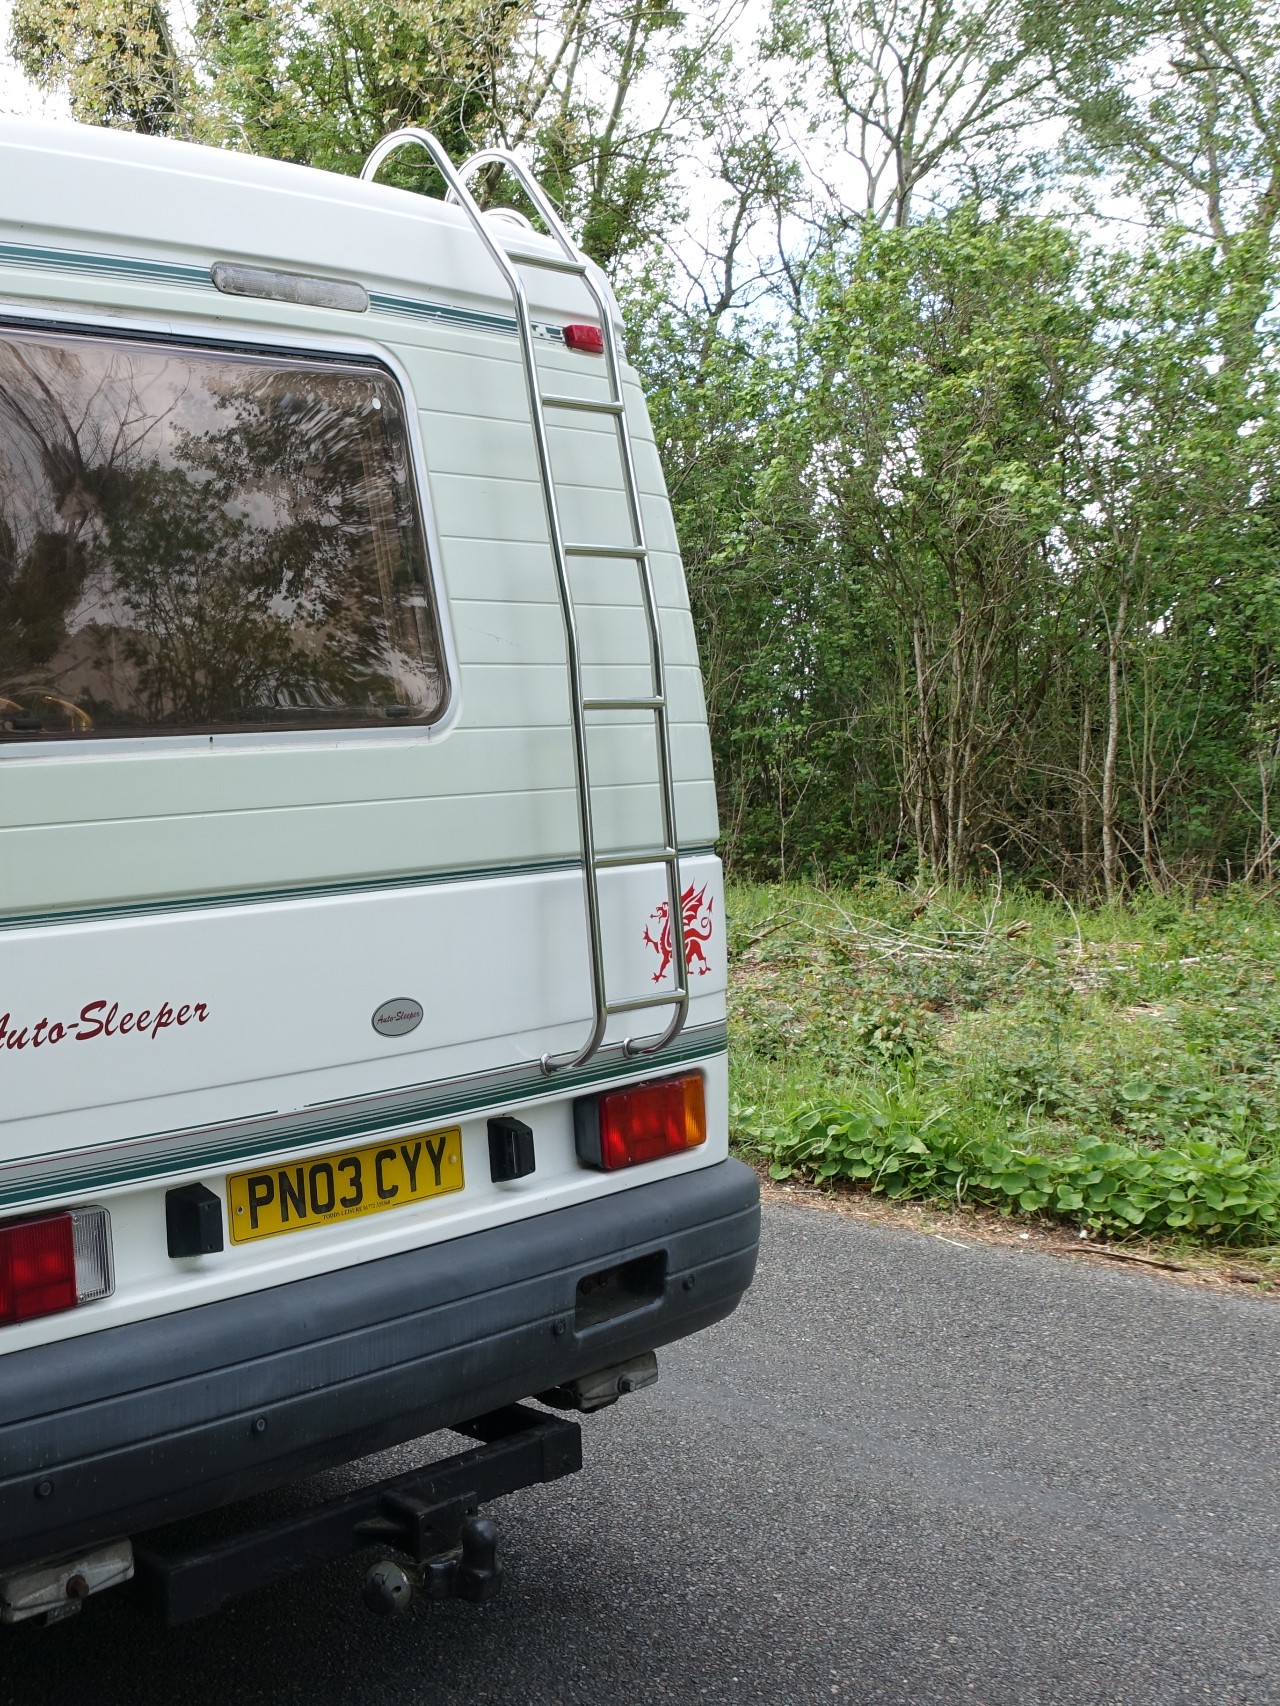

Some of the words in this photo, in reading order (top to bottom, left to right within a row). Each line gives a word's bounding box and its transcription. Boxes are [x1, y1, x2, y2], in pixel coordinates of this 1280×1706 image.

[376, 1011, 420, 1025] Auto-Sleeper
[247, 1156, 364, 1230] PN03
[375, 1136, 446, 1200] CYY
